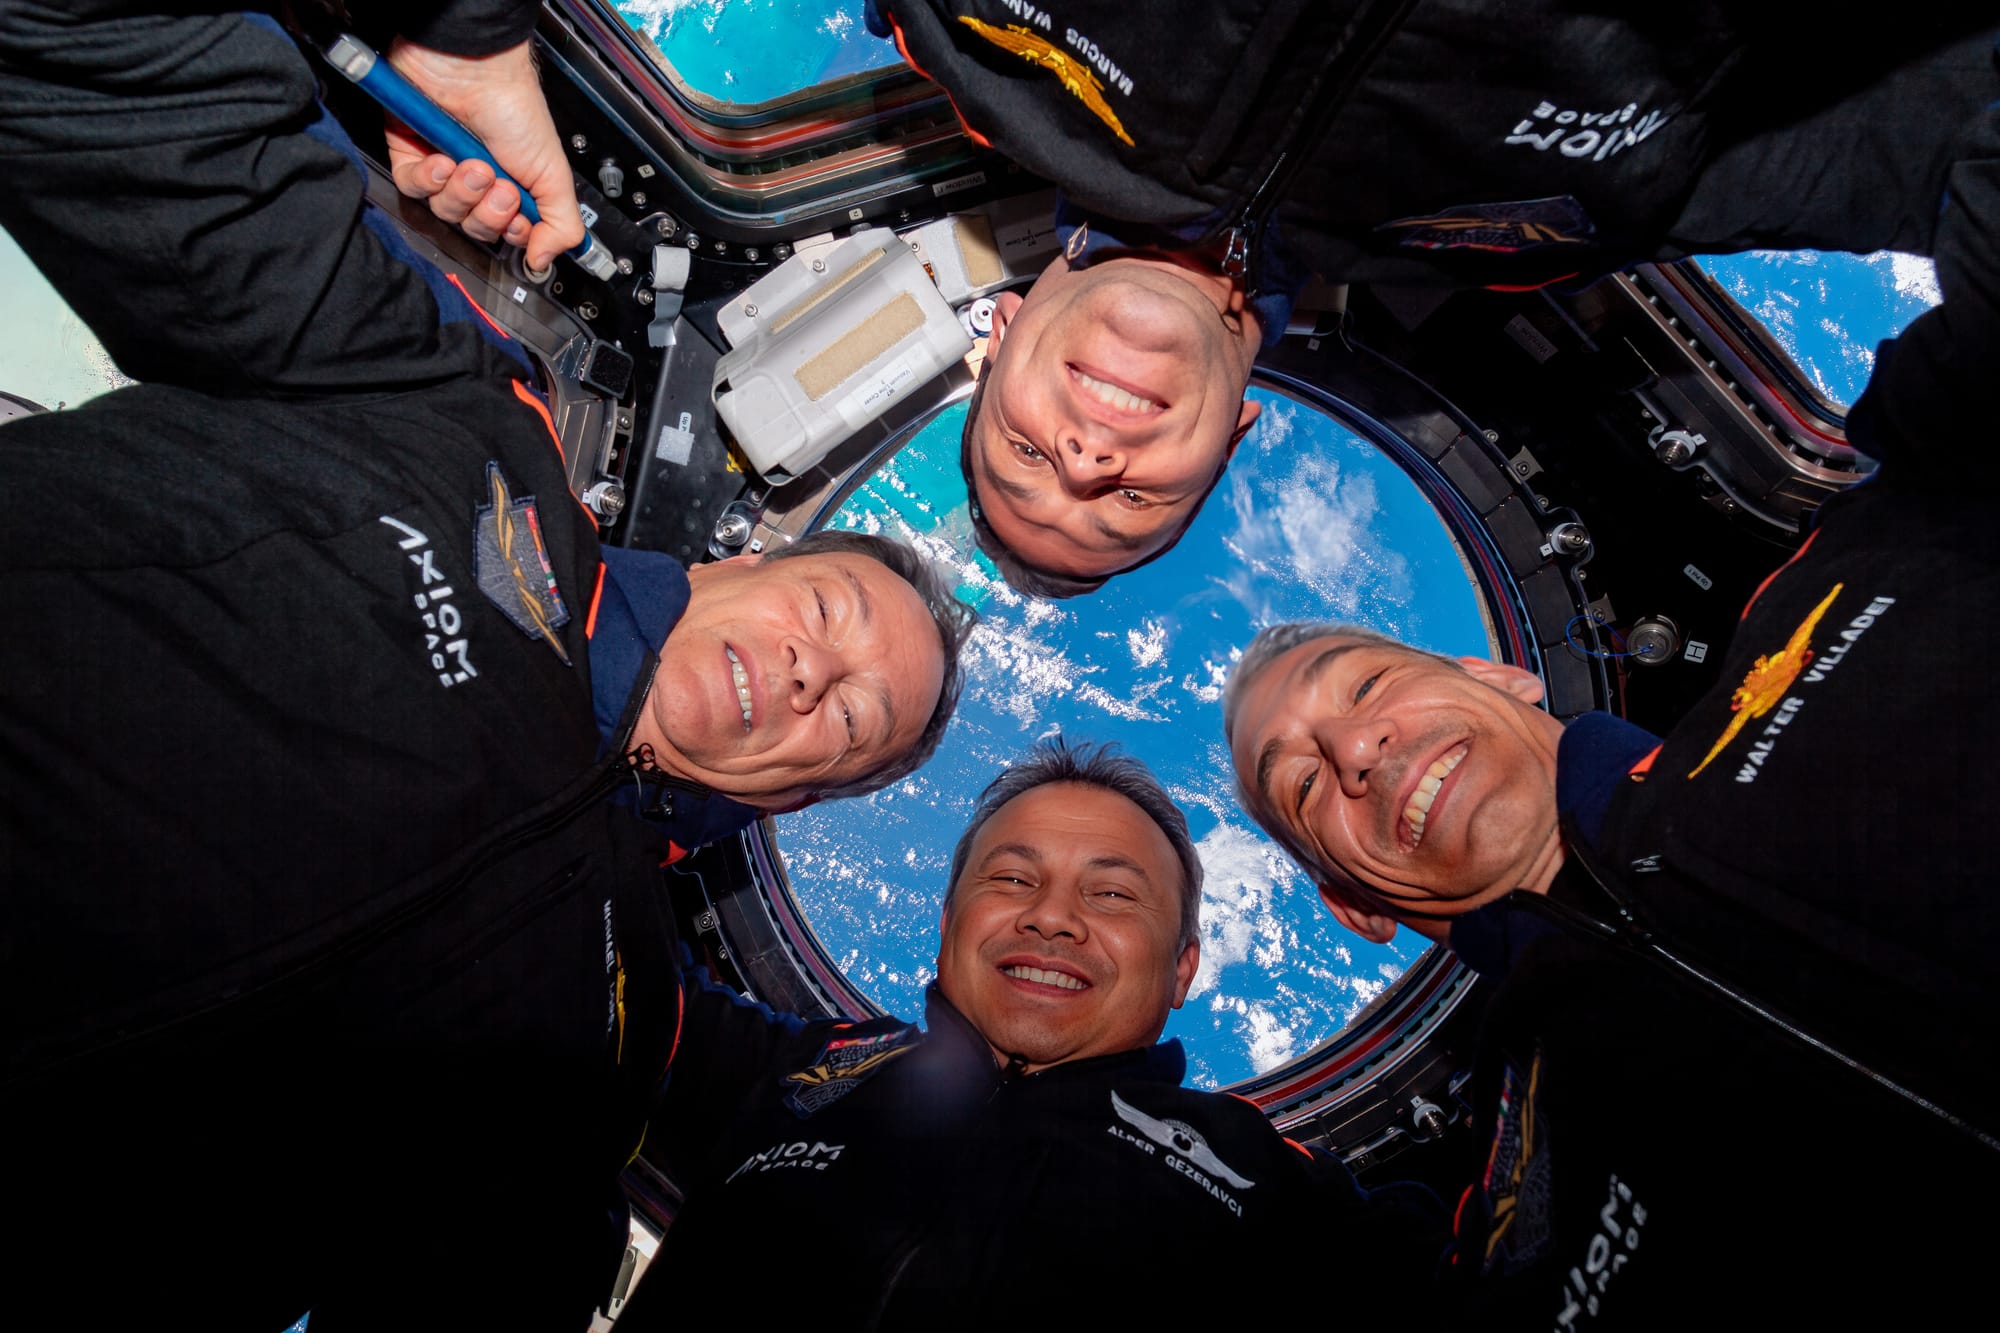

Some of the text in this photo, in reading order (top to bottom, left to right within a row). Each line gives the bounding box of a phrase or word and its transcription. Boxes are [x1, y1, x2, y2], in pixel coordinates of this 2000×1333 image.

[1002, 0, 1134, 97] MARCUS WAN
[1532, 100, 1638, 127] SPACE
[379, 515, 478, 684] AXIOM
[414, 592, 454, 688] SPACE
[1735, 596, 1896, 783] WALTER VILLADEI
[724, 1141, 846, 1184] AXIOM
[1107, 1125, 1244, 1218] ALPER GEZERAVCI
[1554, 1173, 1633, 1333] XIOM
